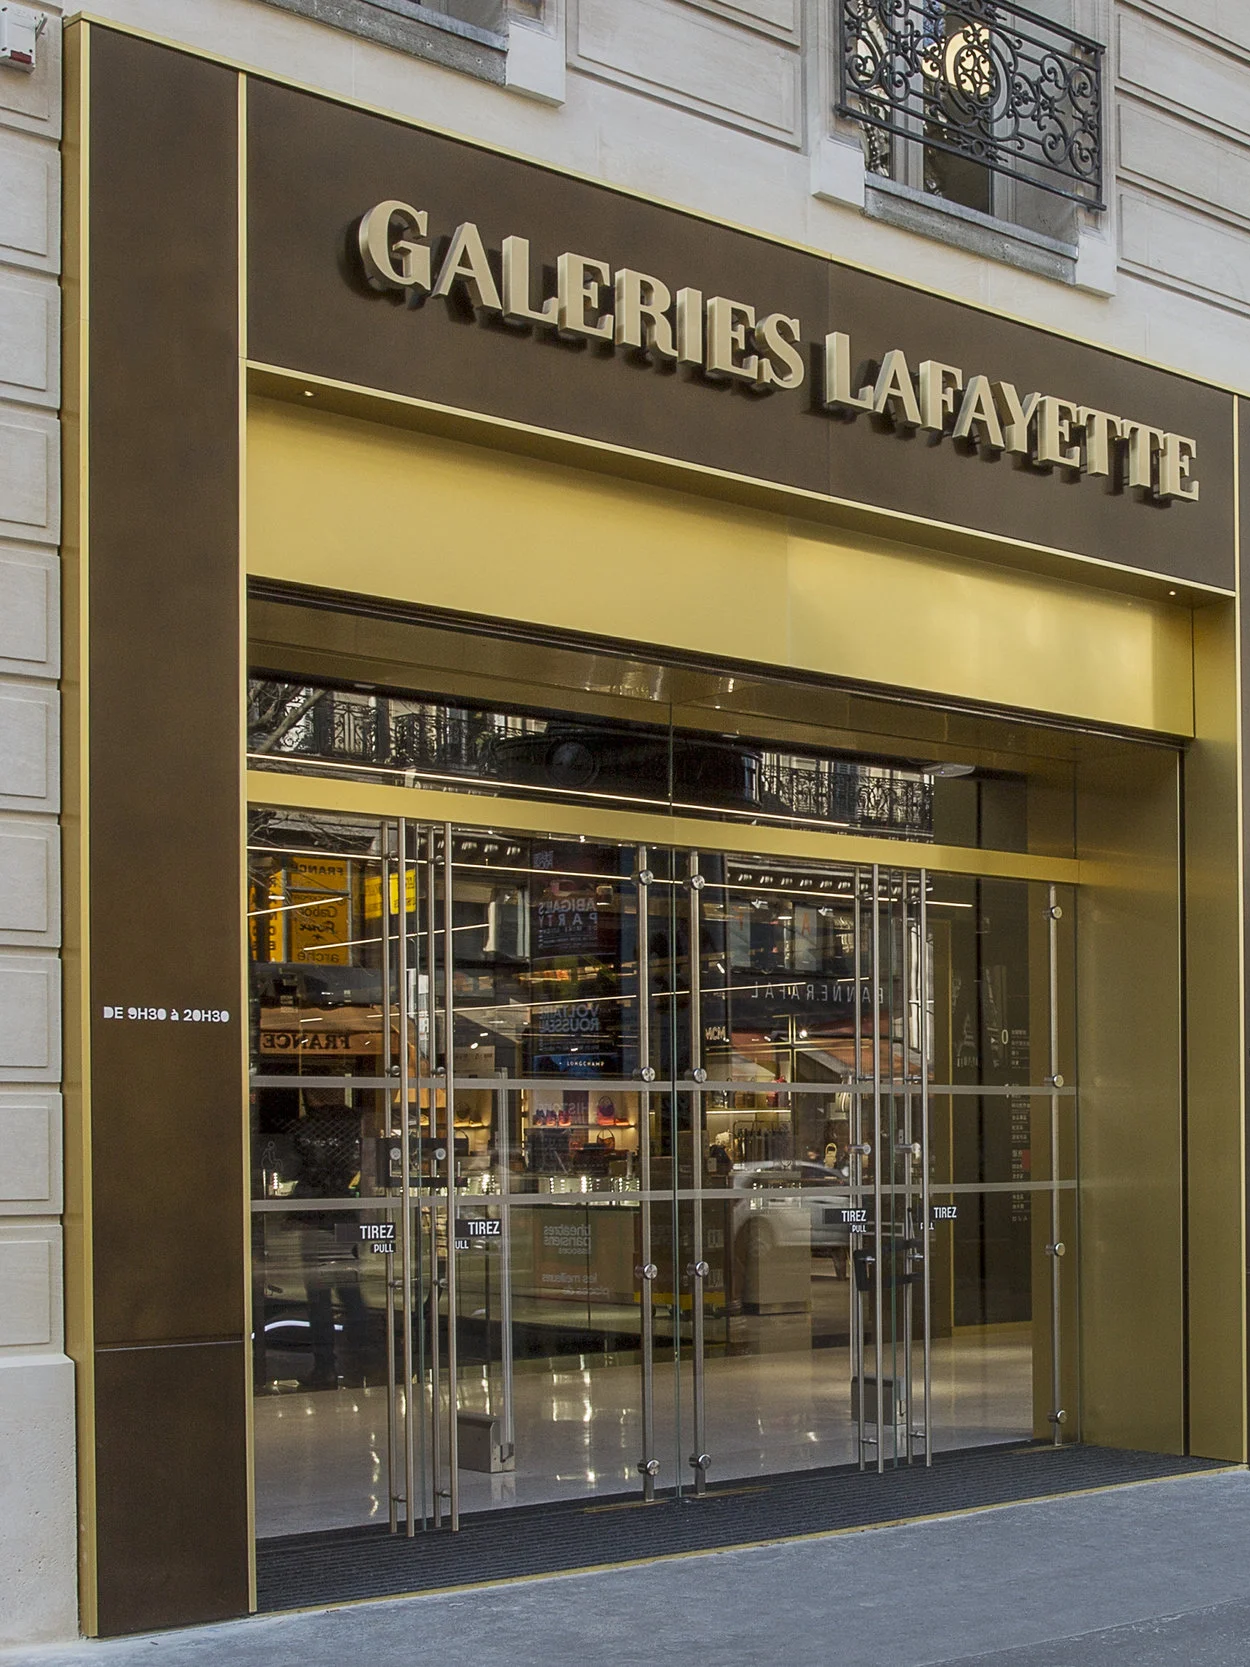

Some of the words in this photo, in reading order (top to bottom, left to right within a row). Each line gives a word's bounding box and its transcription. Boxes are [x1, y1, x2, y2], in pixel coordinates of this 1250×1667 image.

[359, 200, 804, 389] GALERIES
[825, 331, 1199, 501] LAFAYETTE
[103, 1006, 124, 1019] DE
[128, 1007, 168, 1021] 9H30
[183, 1009, 230, 1023] 20H30
[841, 1210, 867, 1222] TIREZ
[933, 1206, 957, 1218] TIREZ
[360, 1225, 394, 1239] TIREZ
[467, 1221, 500, 1235] TIREZ
[852, 1224, 867, 1233] PULL
[373, 1243, 394, 1253] PULL
[455, 1240, 469, 1249] ULL
